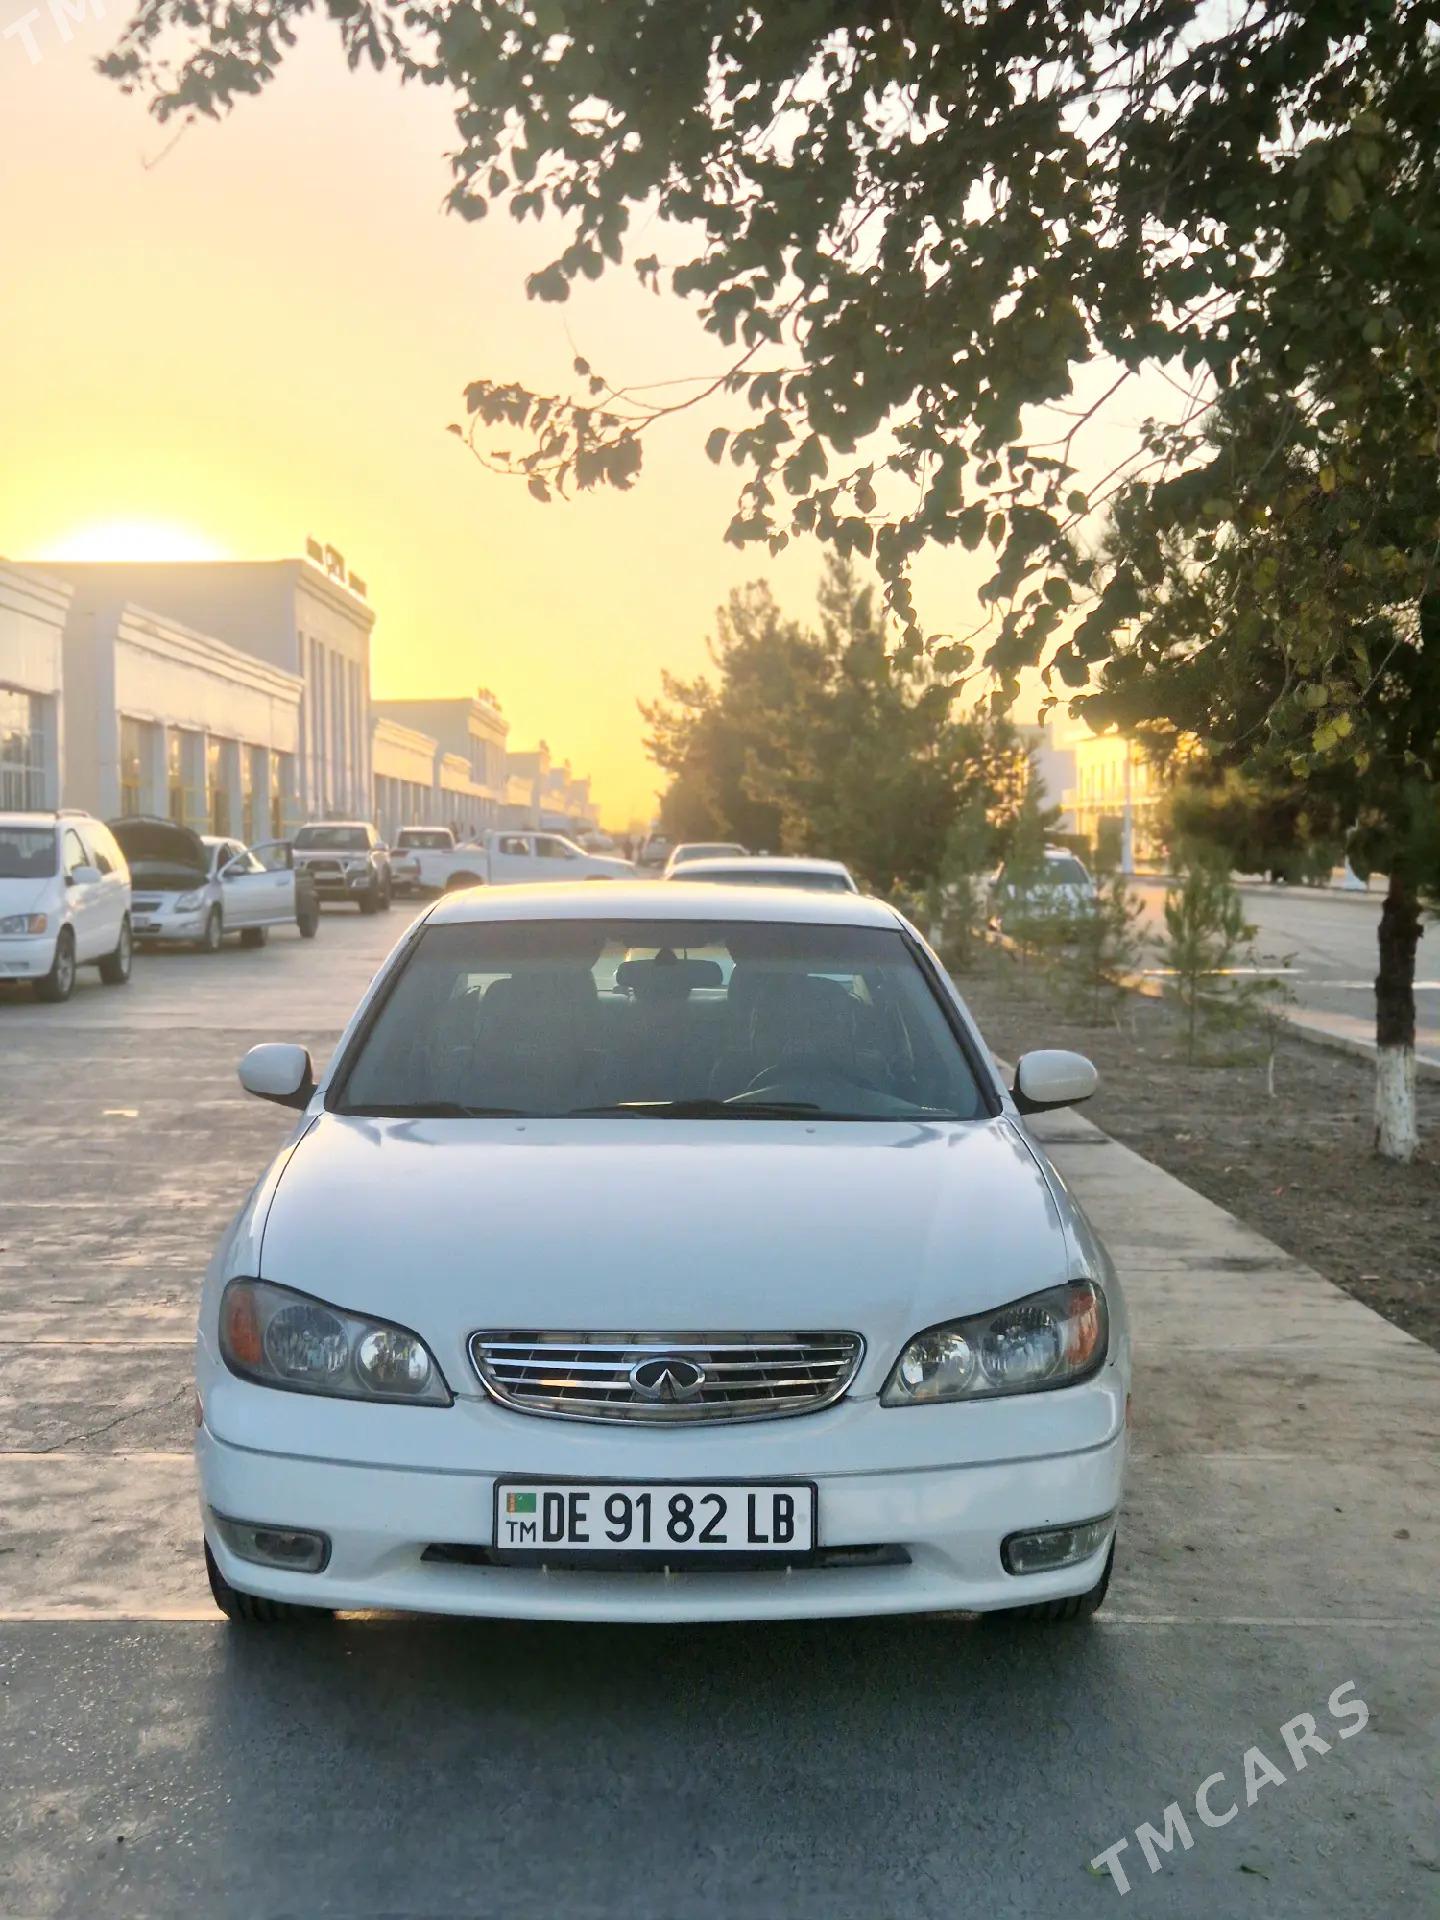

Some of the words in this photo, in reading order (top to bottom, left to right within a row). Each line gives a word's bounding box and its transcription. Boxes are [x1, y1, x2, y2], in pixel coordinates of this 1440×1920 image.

[506, 1521, 536, 1542] TM
[543, 1492, 590, 1542] DE
[747, 1494, 794, 1543] LB
